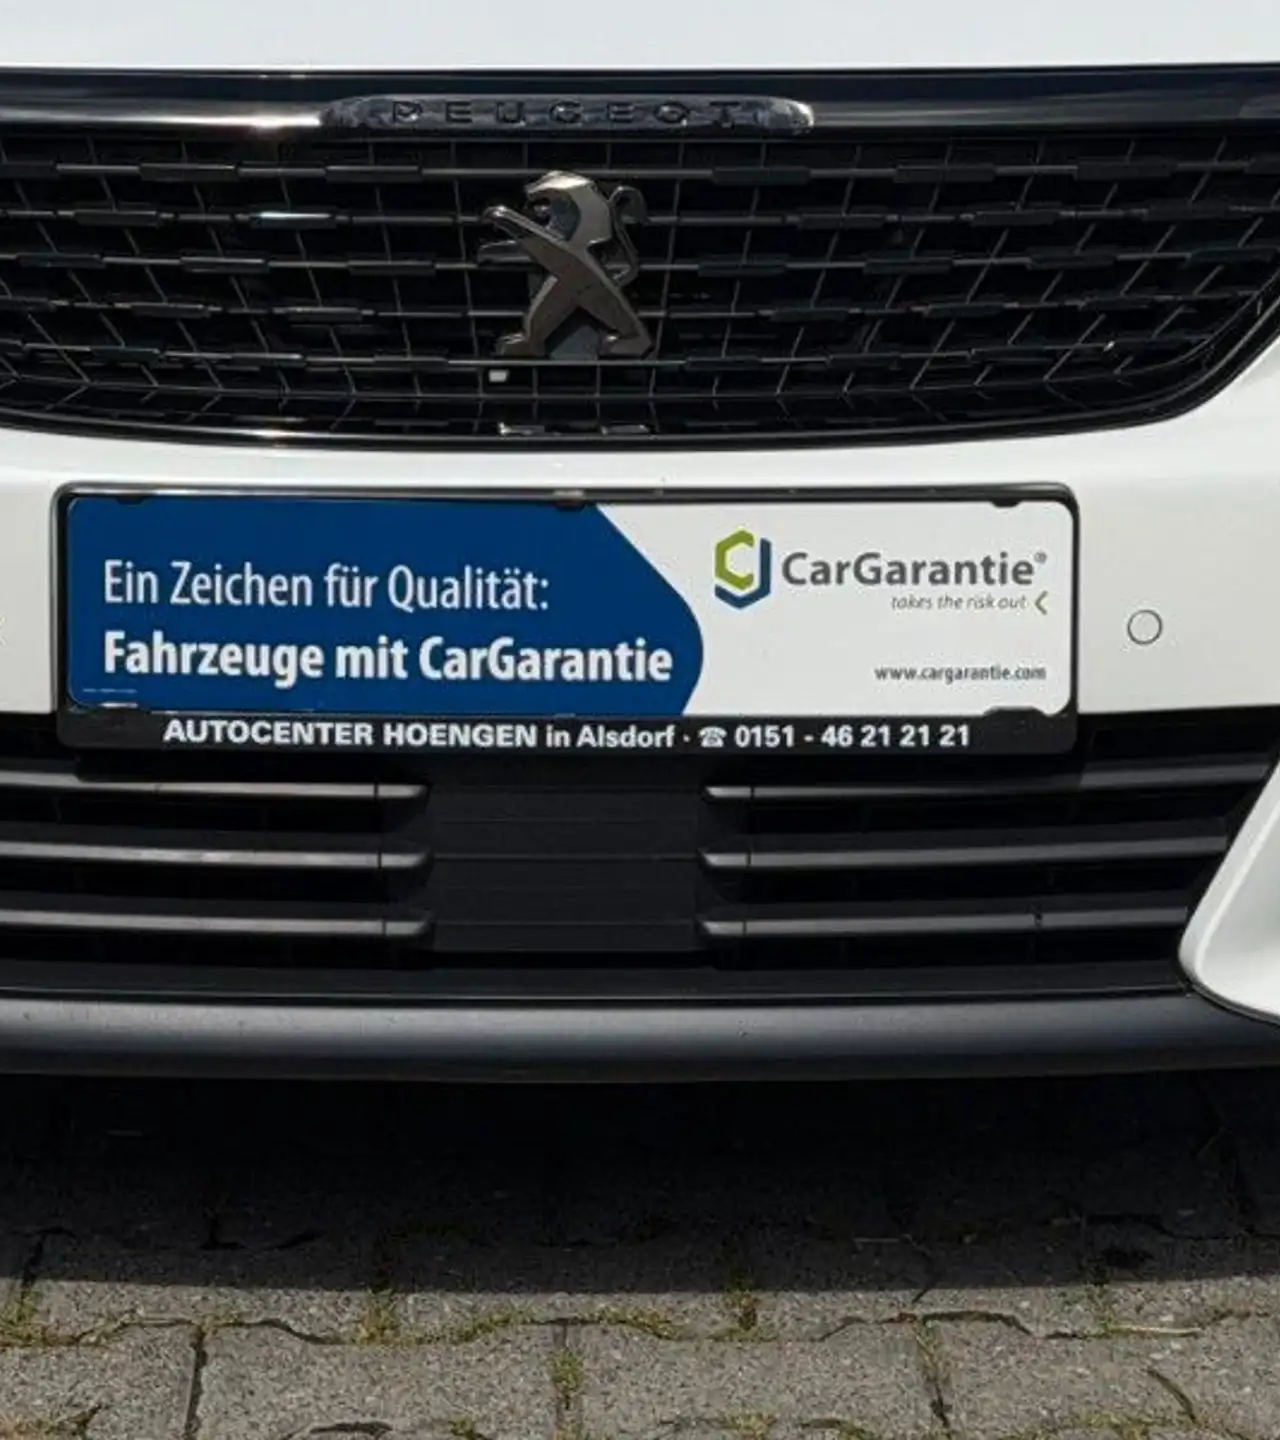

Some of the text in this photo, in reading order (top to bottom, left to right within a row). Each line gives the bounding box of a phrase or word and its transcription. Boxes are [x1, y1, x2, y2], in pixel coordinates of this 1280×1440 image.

[391, 99, 741, 128] PEUGEOT
[104, 559, 550, 612] Ein Zeichen für Qualität:
[891, 593, 1026, 611] takes the risk out
[104, 629, 673, 690] Fahrzeuge mit CarGarantie
[874, 664, 1047, 684] www.cargarantie.com
[162, 718, 374, 746] AUTOCENTER
[383, 722, 538, 748] HOENGEN
[546, 724, 570, 749] in
[576, 724, 676, 749] Alsdorf
[734, 724, 795, 748] 0151
[820, 724, 854, 748] 46
[860, 724, 891, 748] 21
[899, 724, 930, 748] 21
[939, 724, 970, 748] 21
